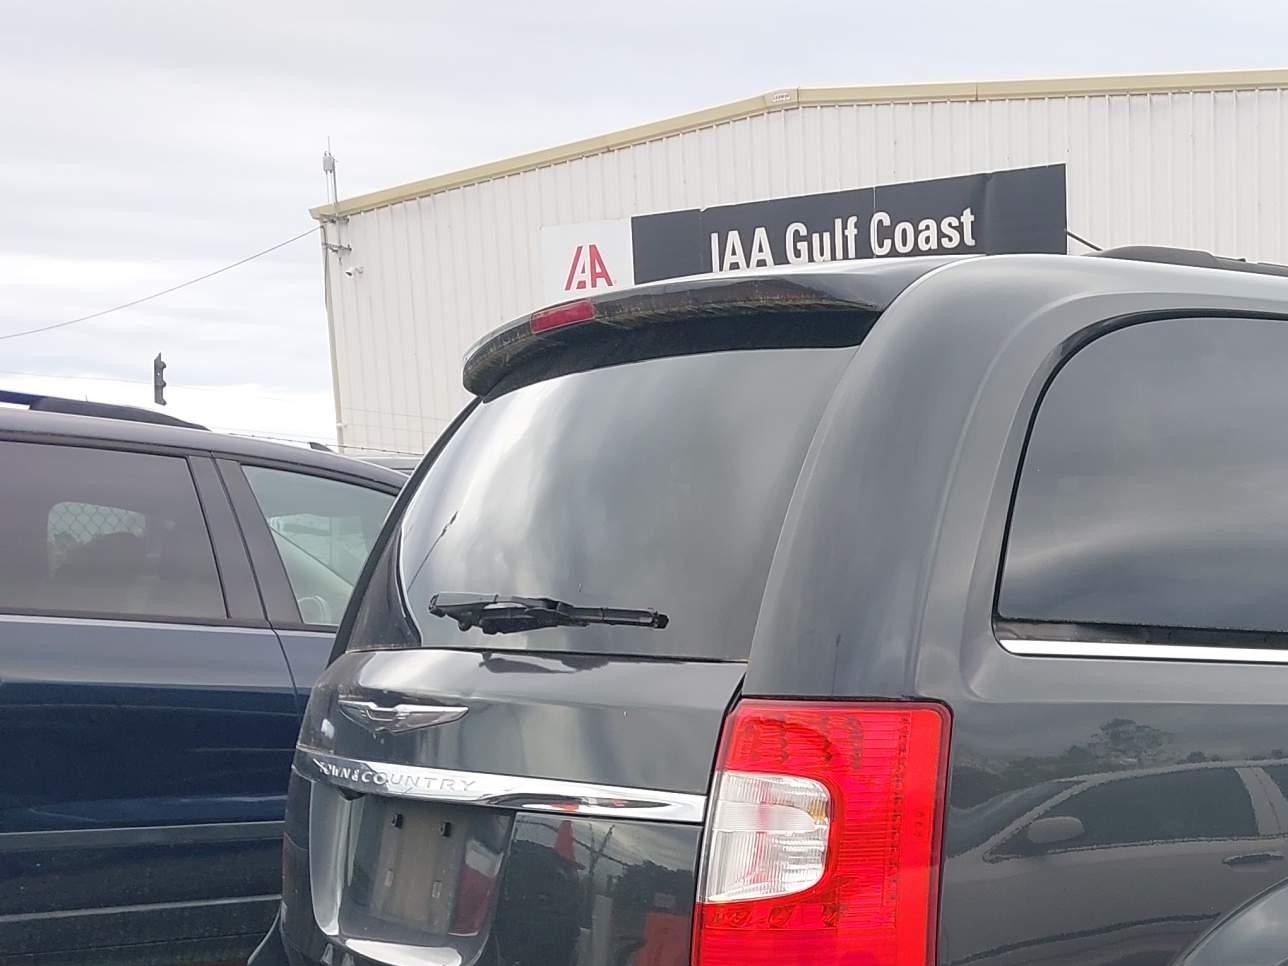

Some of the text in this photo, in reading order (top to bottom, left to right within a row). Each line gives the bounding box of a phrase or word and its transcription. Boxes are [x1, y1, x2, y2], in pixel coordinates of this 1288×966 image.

[709, 207, 976, 273] IAA Gulf Coast
